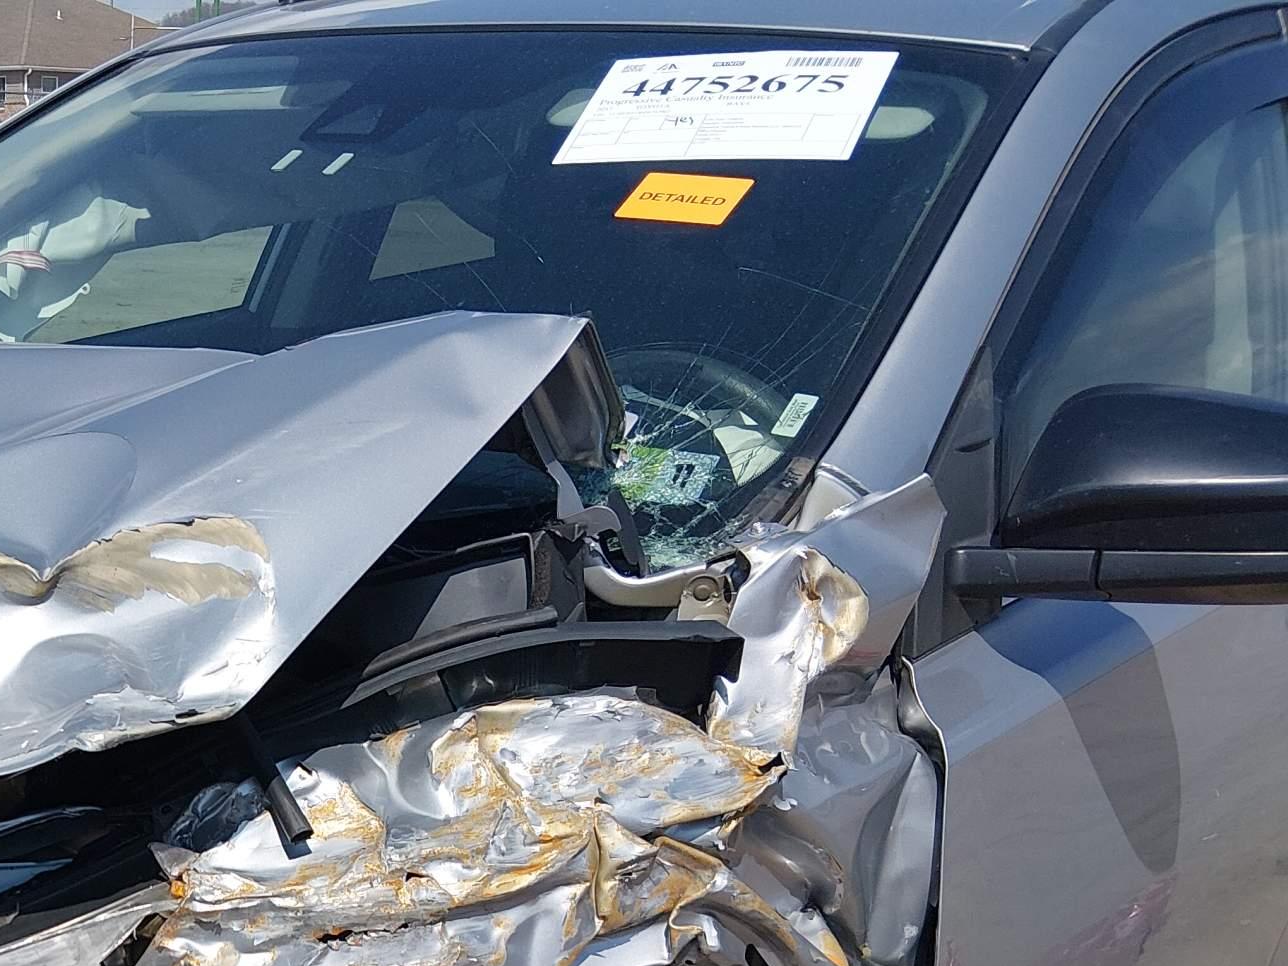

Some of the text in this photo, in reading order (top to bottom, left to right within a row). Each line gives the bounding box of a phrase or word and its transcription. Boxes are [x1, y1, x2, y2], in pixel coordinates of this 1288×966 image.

[622, 74, 849, 97] 44752675
[717, 93, 774, 101] Insurance
[638, 191, 727, 206] DETAILED
